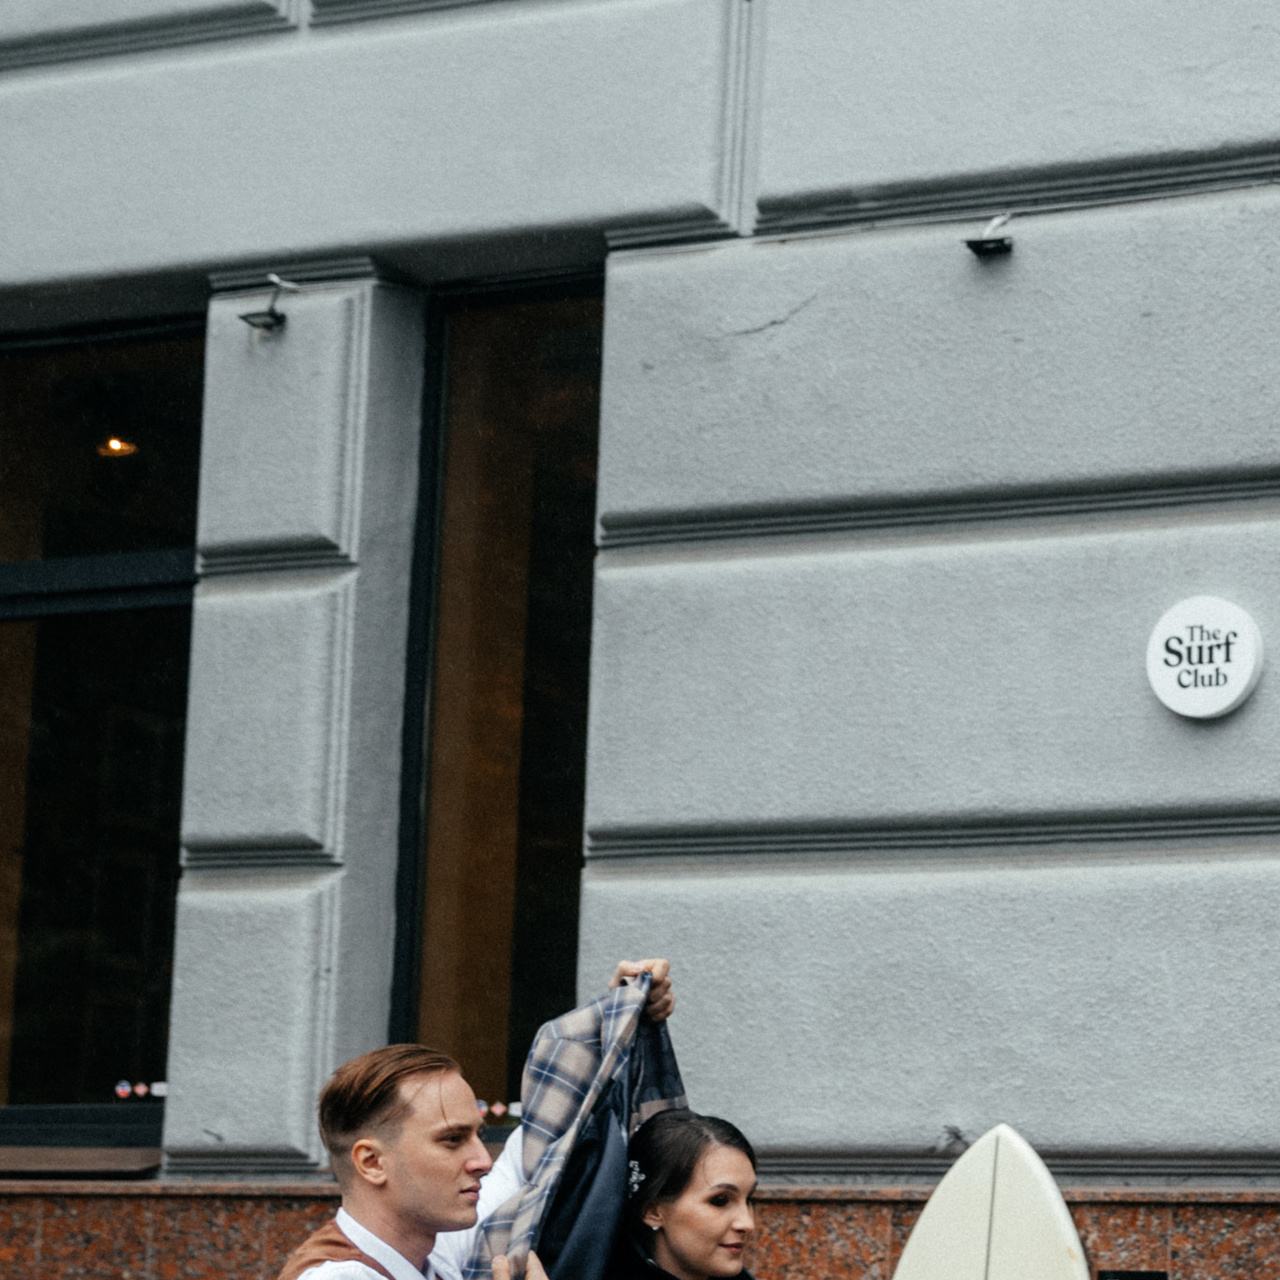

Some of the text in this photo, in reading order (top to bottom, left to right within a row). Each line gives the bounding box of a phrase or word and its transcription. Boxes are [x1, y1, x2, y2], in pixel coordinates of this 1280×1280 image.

[1186, 624, 1221, 642] The
[1163, 631, 1238, 667] Surf
[1177, 668, 1228, 688] Club
